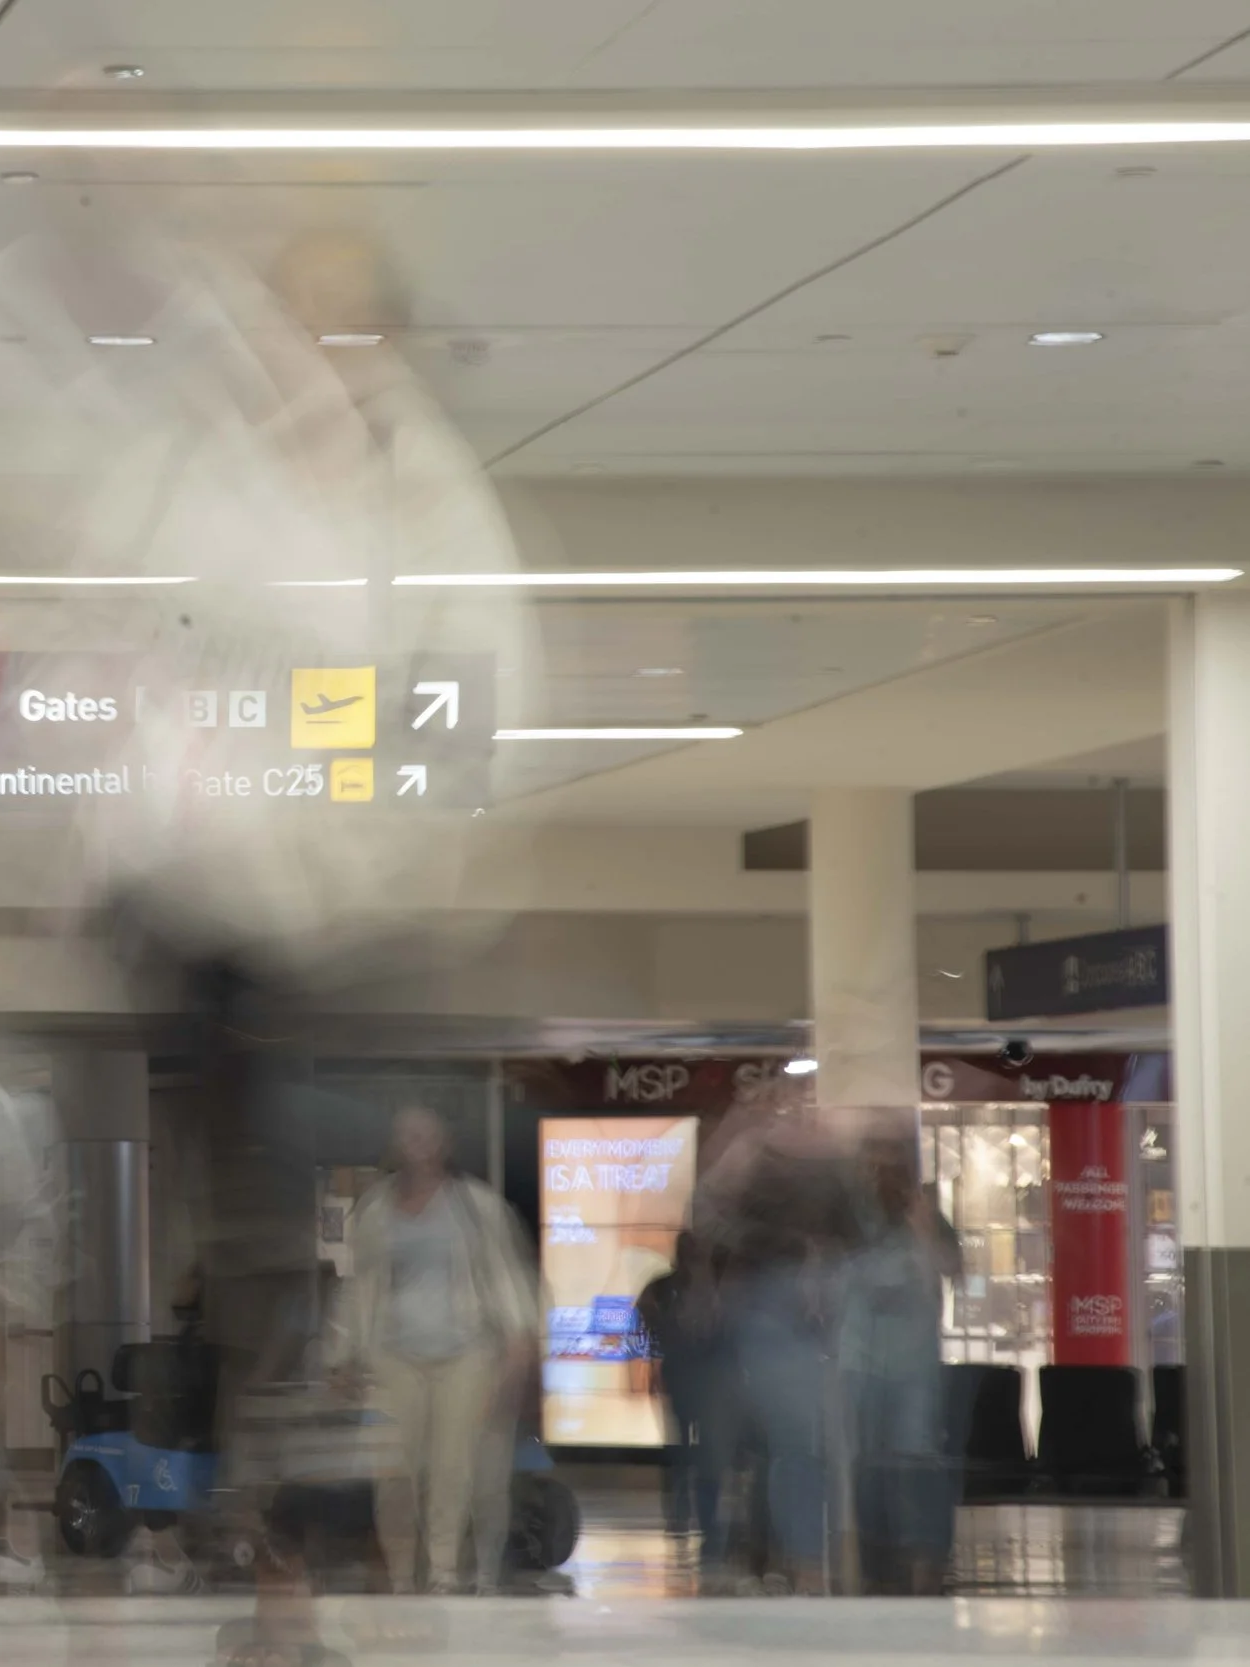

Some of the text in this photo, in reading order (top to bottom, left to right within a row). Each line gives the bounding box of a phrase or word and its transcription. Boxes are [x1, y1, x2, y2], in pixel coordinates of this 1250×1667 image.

[19, 689, 117, 722] Gates
[262, 764, 324, 797] C25
[607, 1064, 690, 1101] MSP
[546, 1138, 602, 1157] EVERY
[546, 1164, 673, 1191] IS A TREAT
